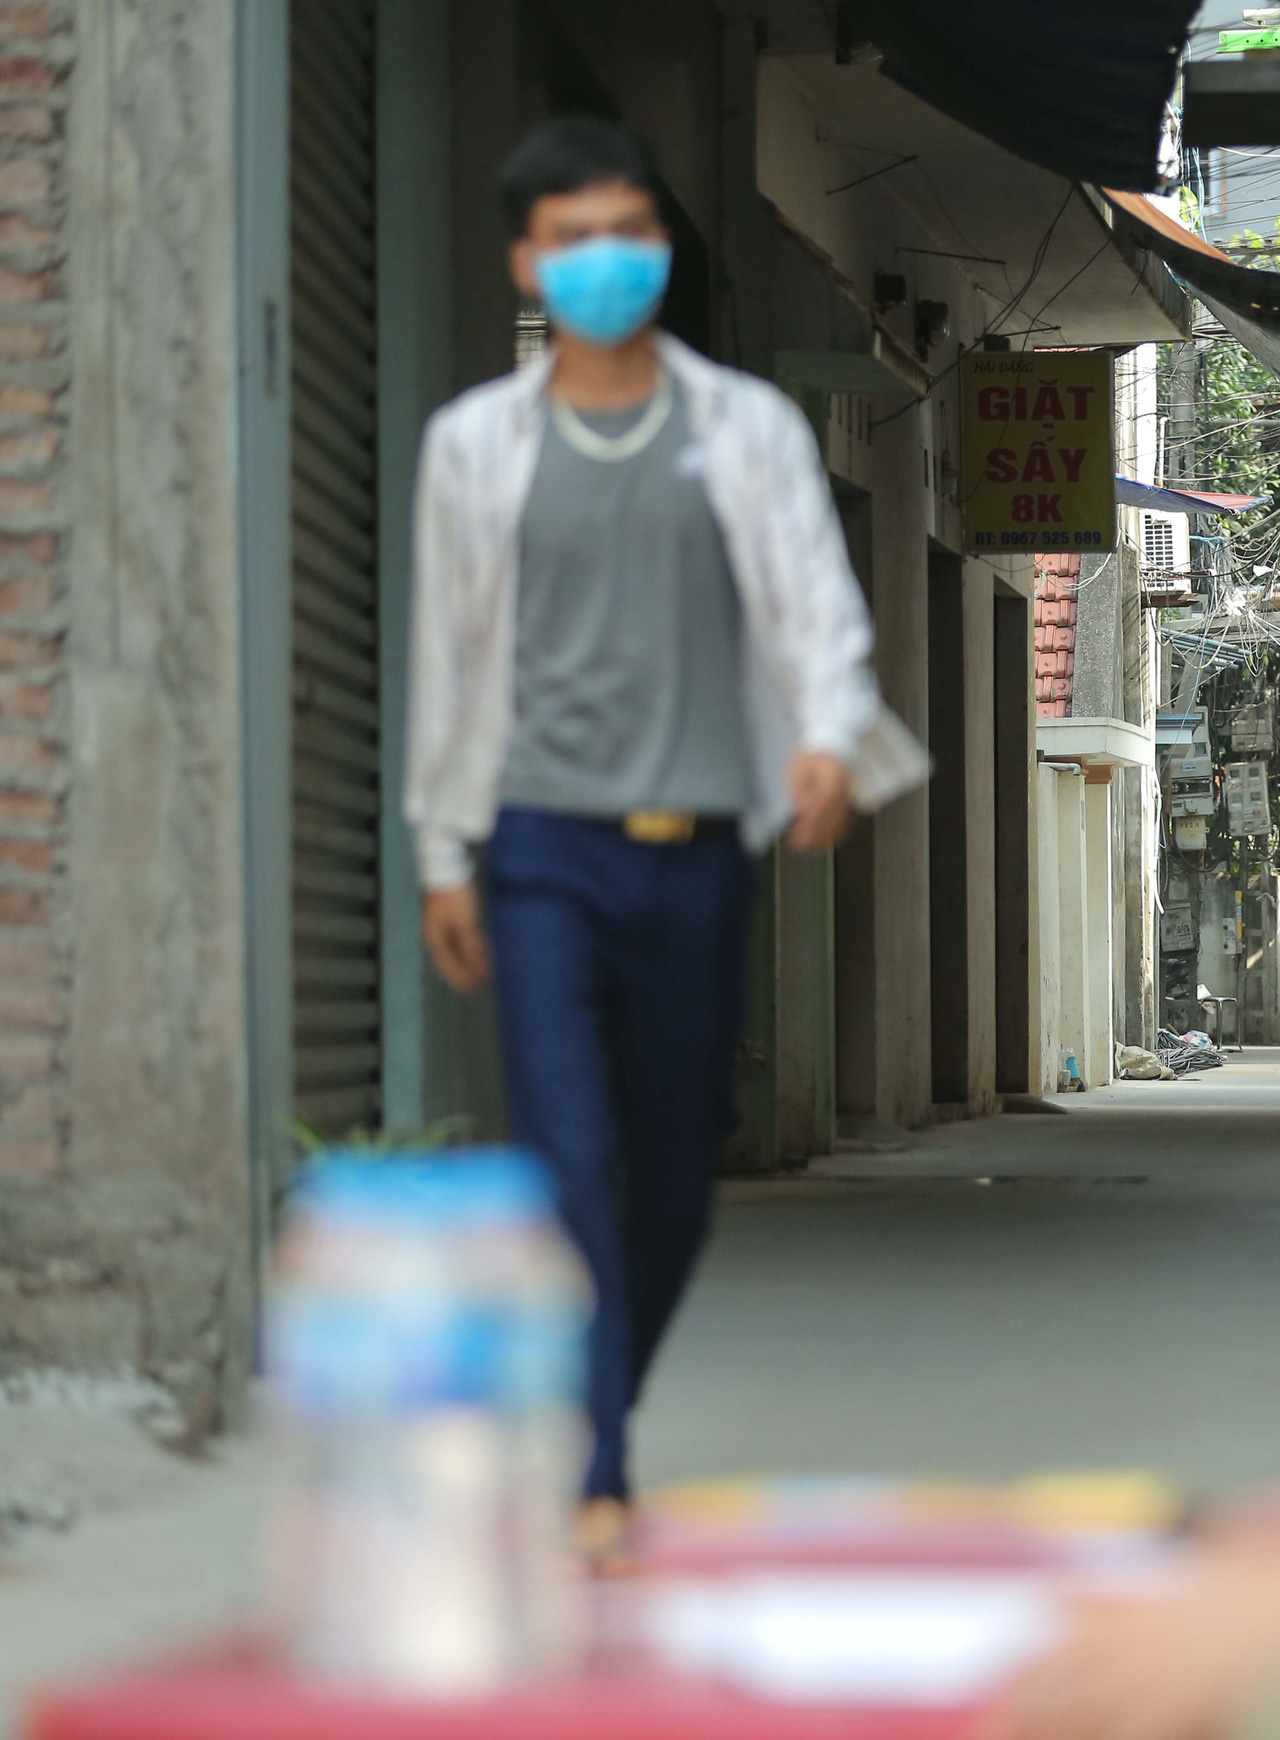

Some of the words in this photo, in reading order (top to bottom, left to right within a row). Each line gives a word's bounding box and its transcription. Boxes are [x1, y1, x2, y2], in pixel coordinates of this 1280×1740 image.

[978, 379, 1095, 429] GIẶT
[985, 435, 1088, 483] SẤY
[1011, 493, 1063, 523] 8K
[1001, 531, 1037, 545] 0967
[1042, 531, 1069, 545] 525
[1074, 531, 1101, 545] 689
